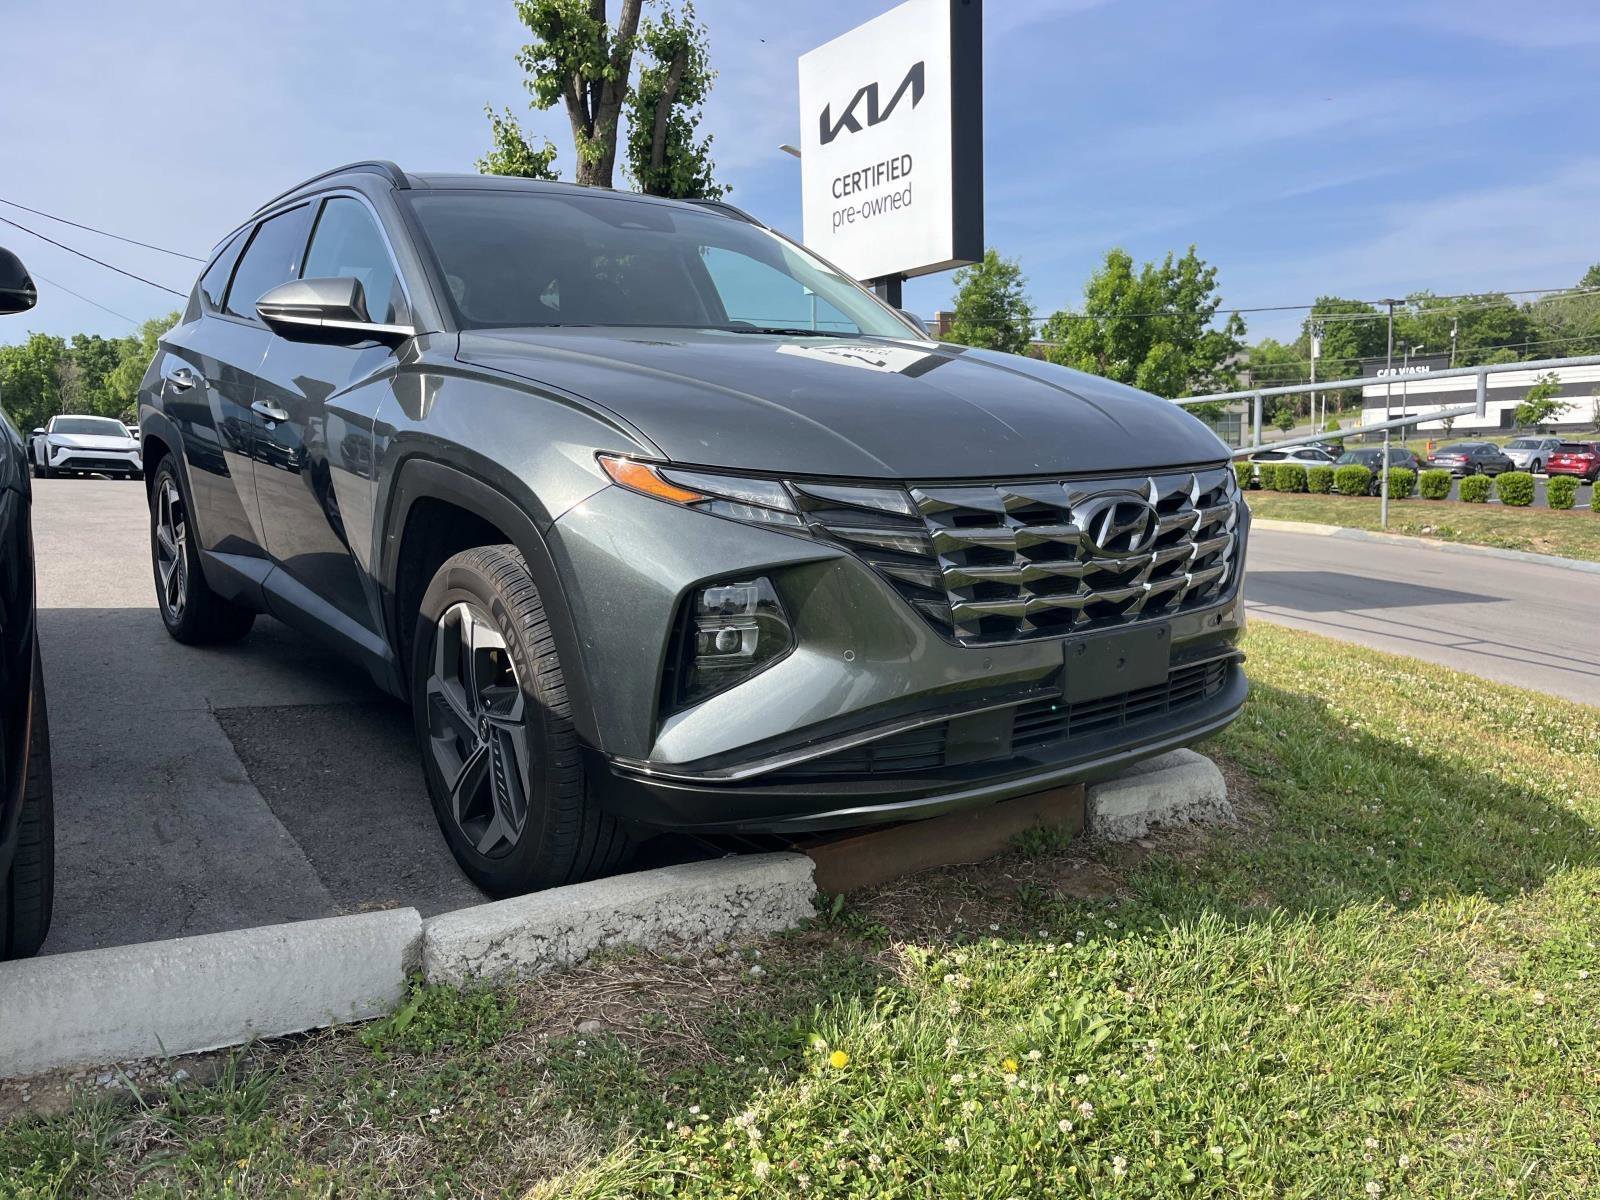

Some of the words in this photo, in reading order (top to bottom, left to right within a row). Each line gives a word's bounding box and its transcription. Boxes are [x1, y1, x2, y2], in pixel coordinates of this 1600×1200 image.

[819, 60, 925, 146] KIA
[832, 153, 913, 200] CERTIFIED
[832, 181, 912, 234] pre-owned
[1376, 368, 1397, 378] CAR
[1398, 366, 1430, 375] WASH
